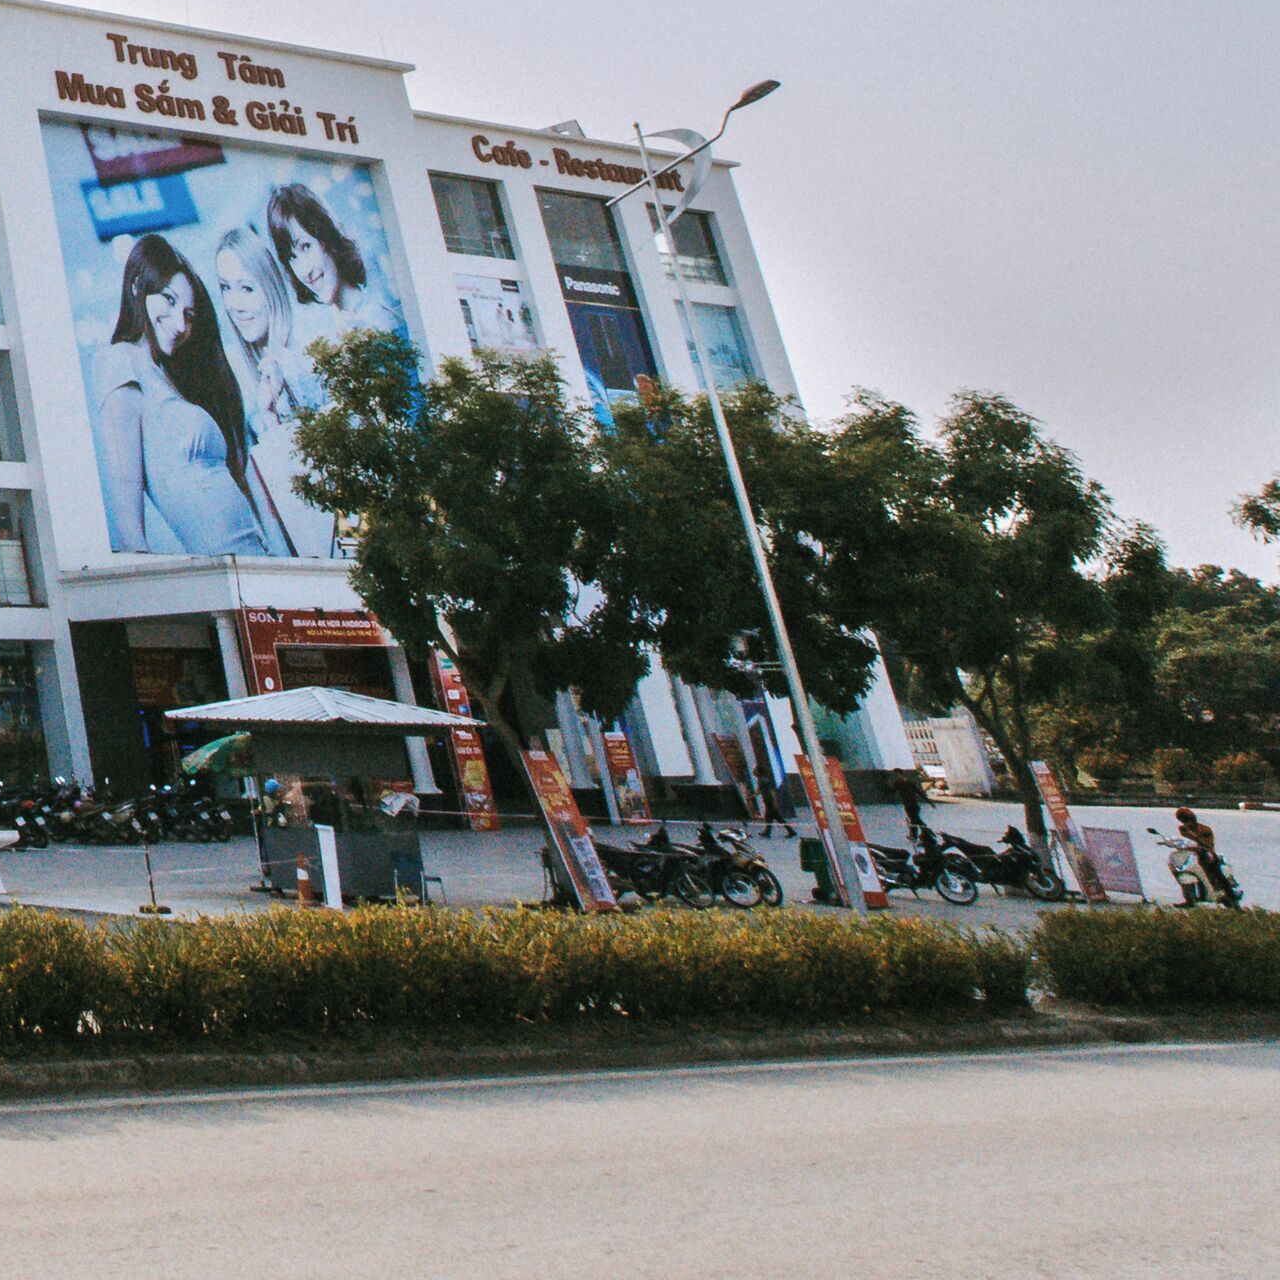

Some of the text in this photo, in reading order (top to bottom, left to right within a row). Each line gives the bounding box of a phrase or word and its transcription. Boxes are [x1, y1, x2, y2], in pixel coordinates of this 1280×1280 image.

[106, 32, 286, 88] Trung Tâm
[54, 70, 360, 144] Mua Sắm & Giải Trí
[564, 276, 621, 296] Panasonic
[342, 620, 371, 629] ANDROID
